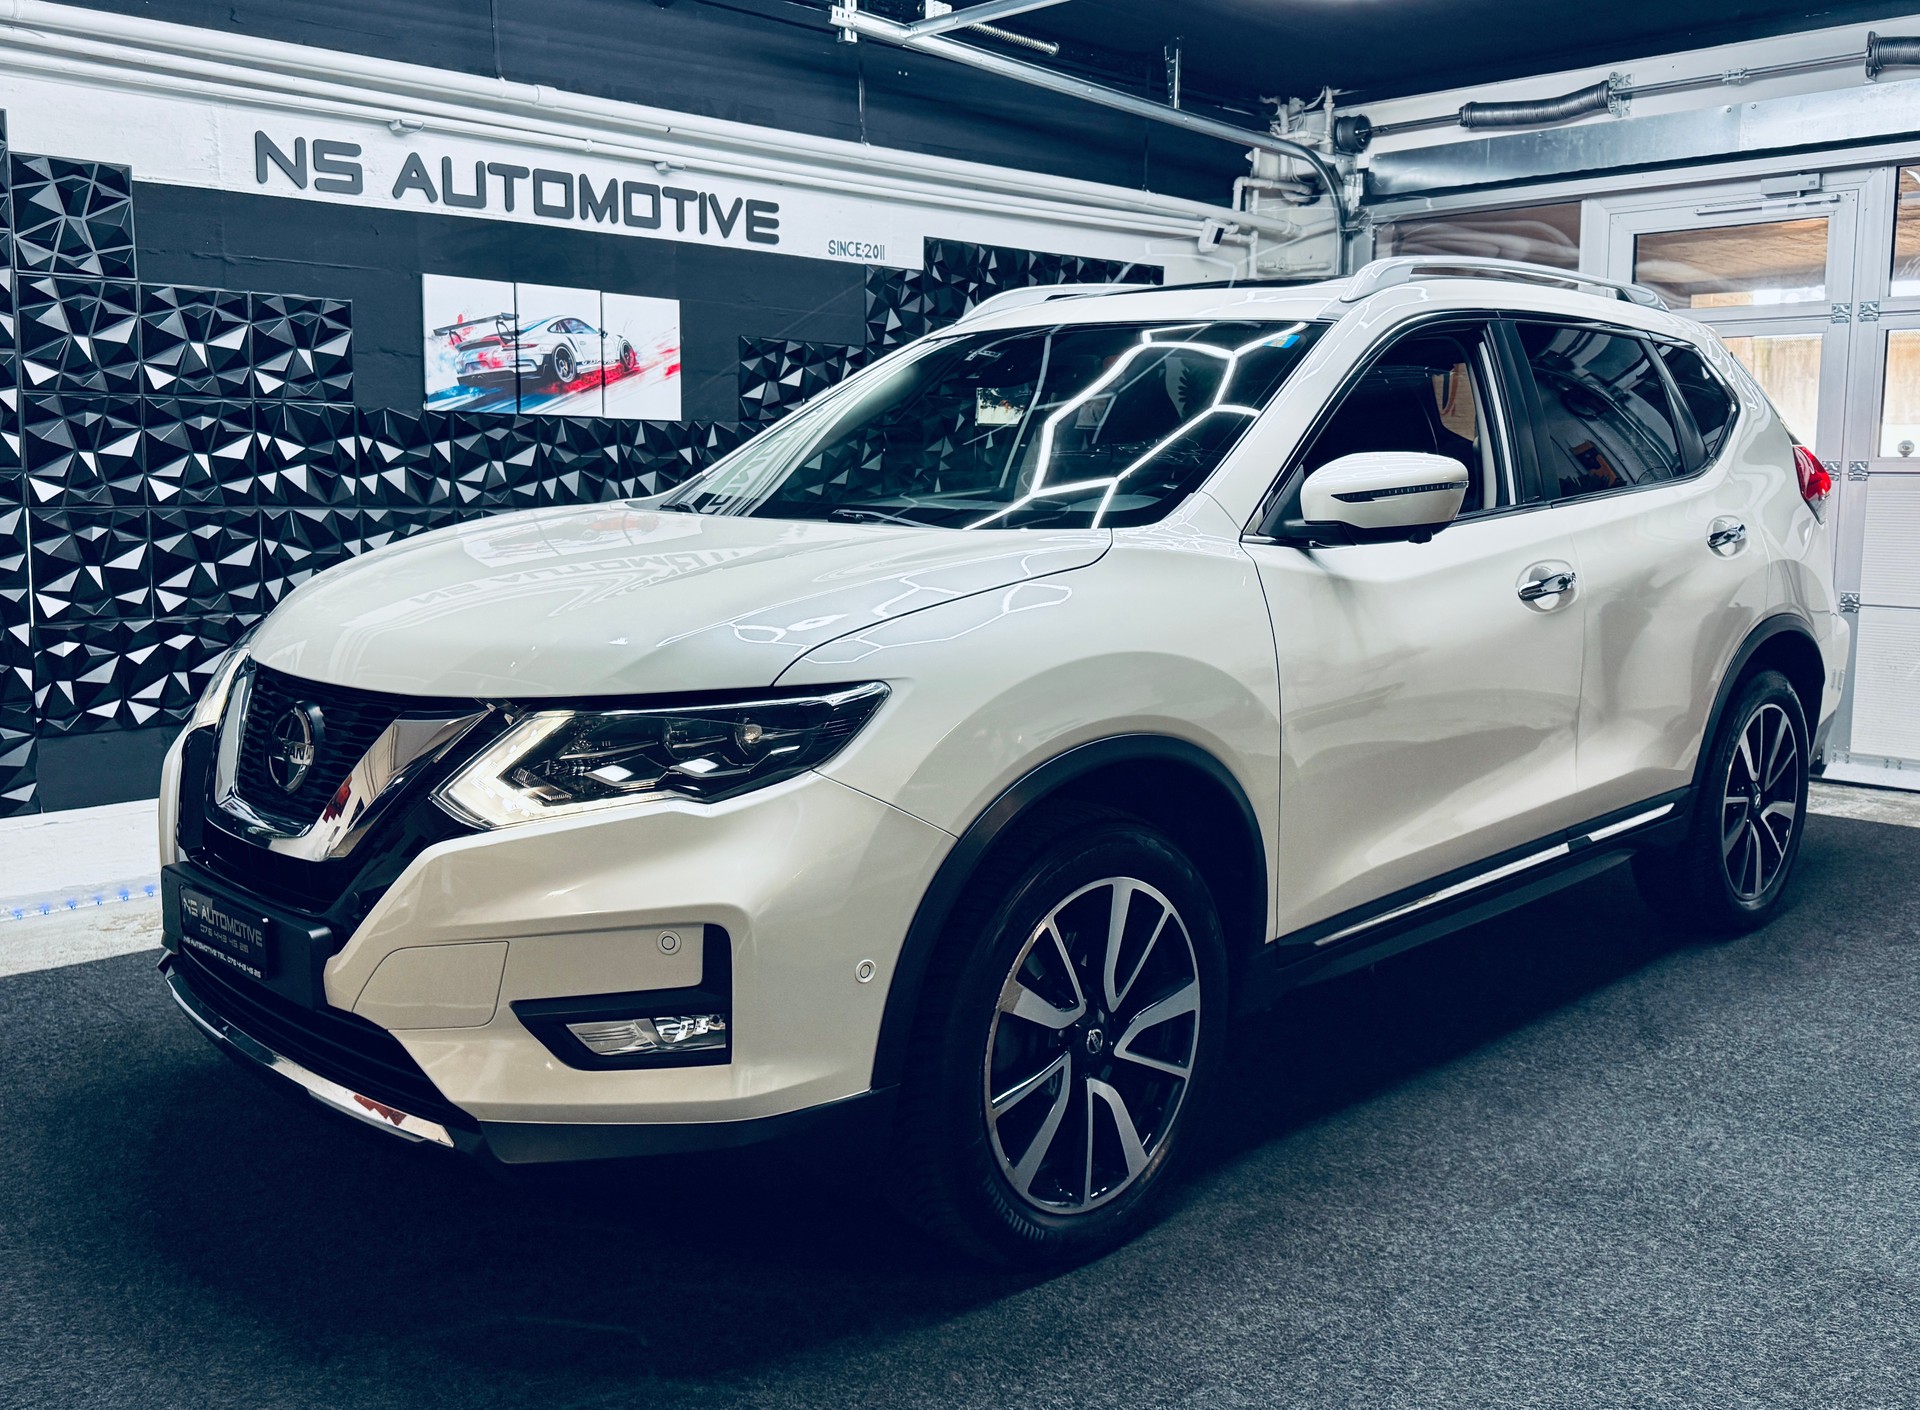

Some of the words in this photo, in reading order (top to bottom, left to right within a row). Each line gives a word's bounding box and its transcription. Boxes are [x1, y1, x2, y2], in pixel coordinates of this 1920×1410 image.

[255, 130, 363, 195] NS
[391, 152, 780, 244] AUTOMOTIVE
[183, 897, 199, 918] NS
[201, 904, 263, 948] AUTOMOTIVE
